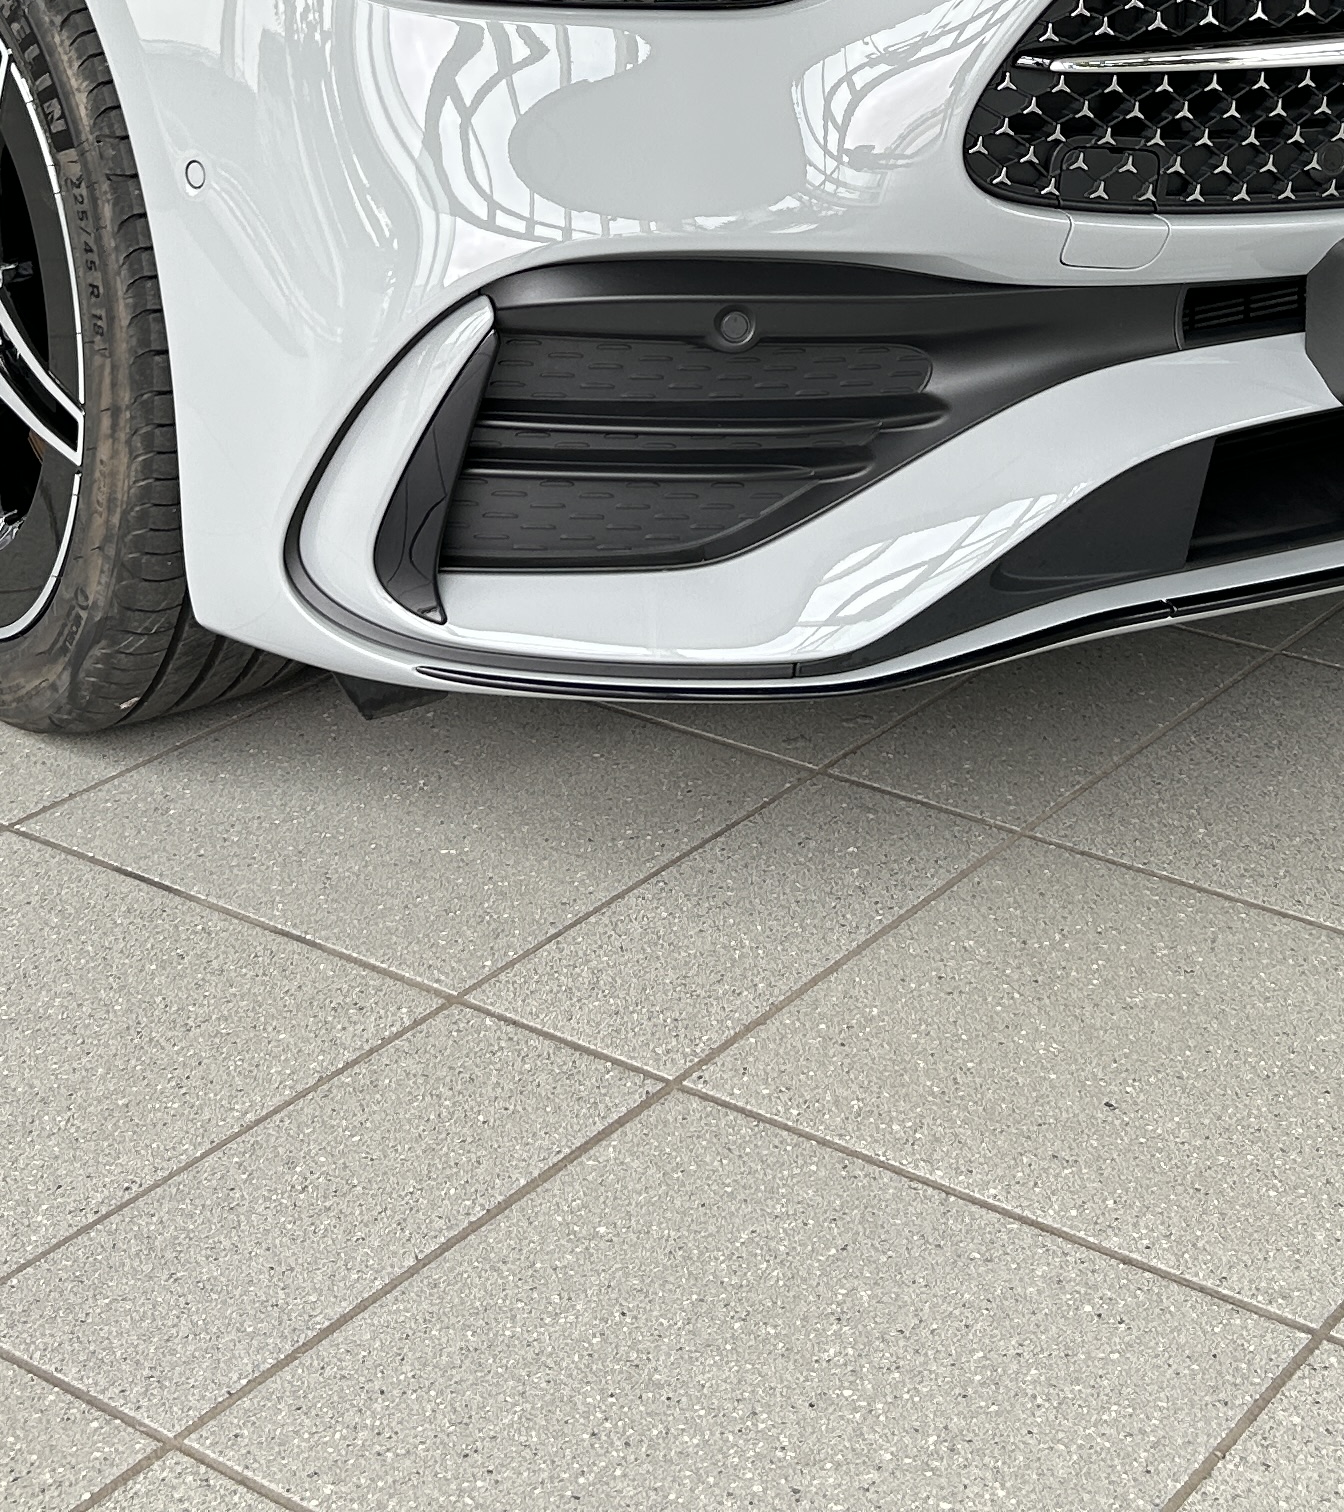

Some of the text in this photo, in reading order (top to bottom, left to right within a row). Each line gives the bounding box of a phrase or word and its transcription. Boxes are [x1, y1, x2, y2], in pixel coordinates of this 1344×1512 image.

[70, 174, 105, 338] 225/45 R 18
